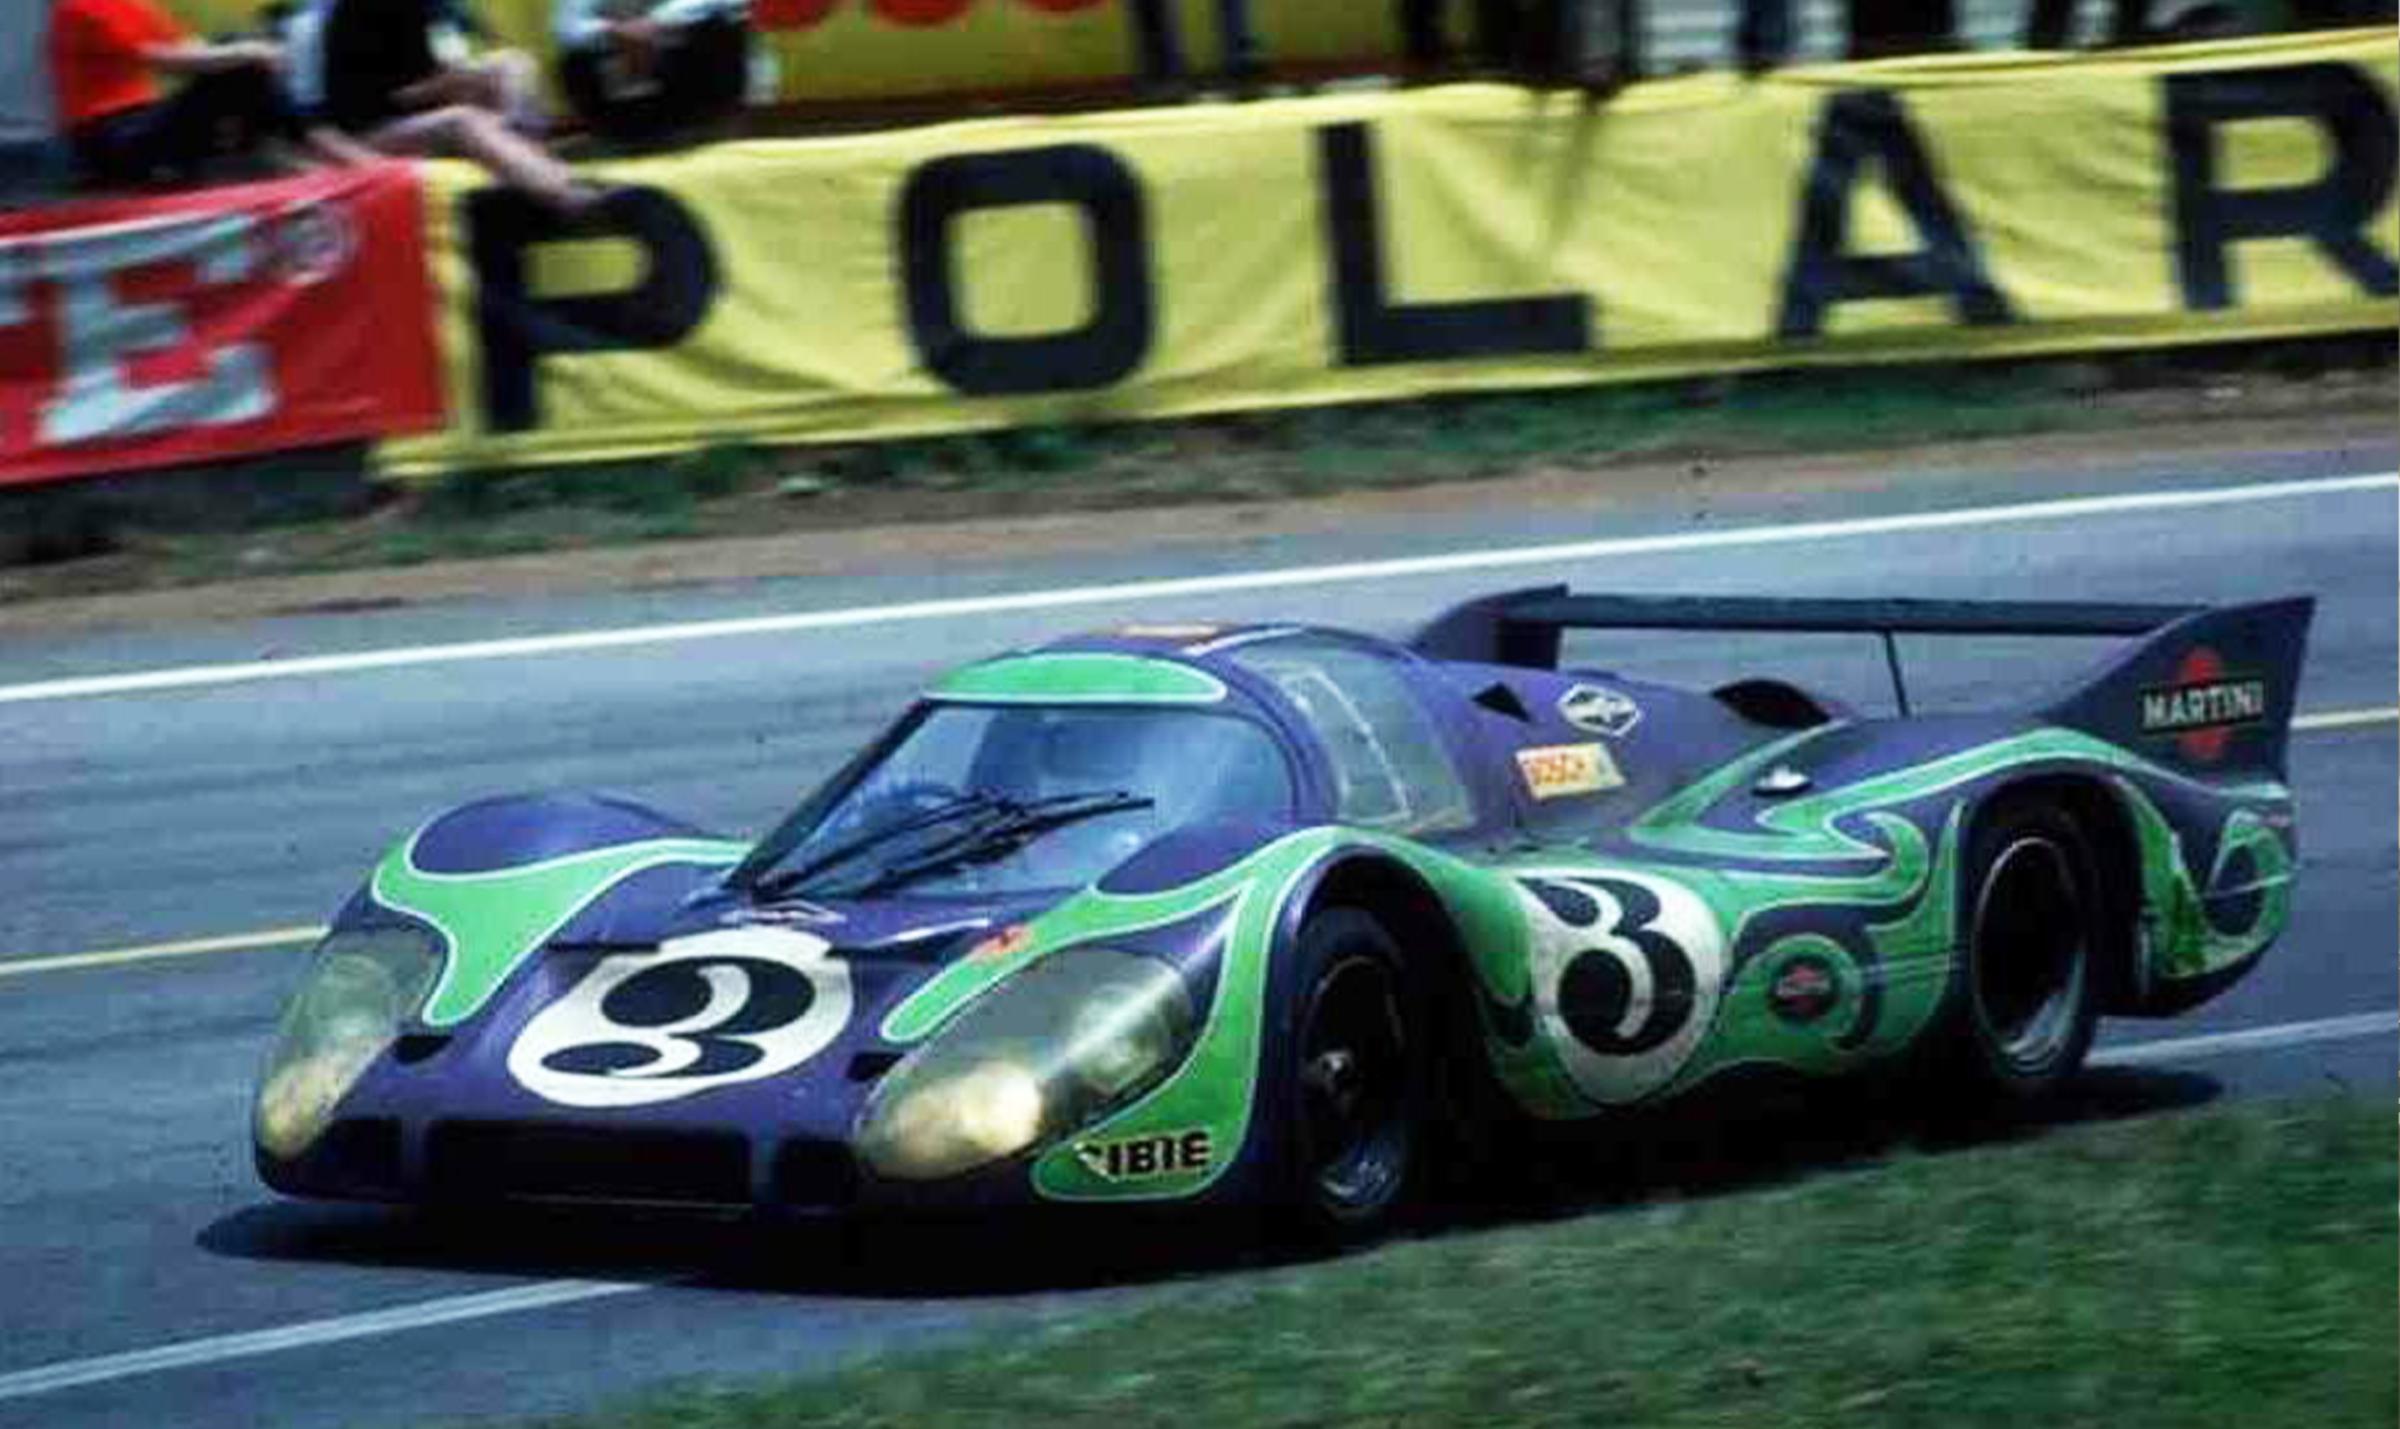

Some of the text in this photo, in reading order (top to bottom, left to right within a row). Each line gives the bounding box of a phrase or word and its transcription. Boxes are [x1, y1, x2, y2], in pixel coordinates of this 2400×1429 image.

[462, 60, 2399, 430] POLAR
[2143, 680, 2265, 729] MARTINI
[540, 956, 816, 1078] 3
[1514, 876, 1697, 1056] 3
